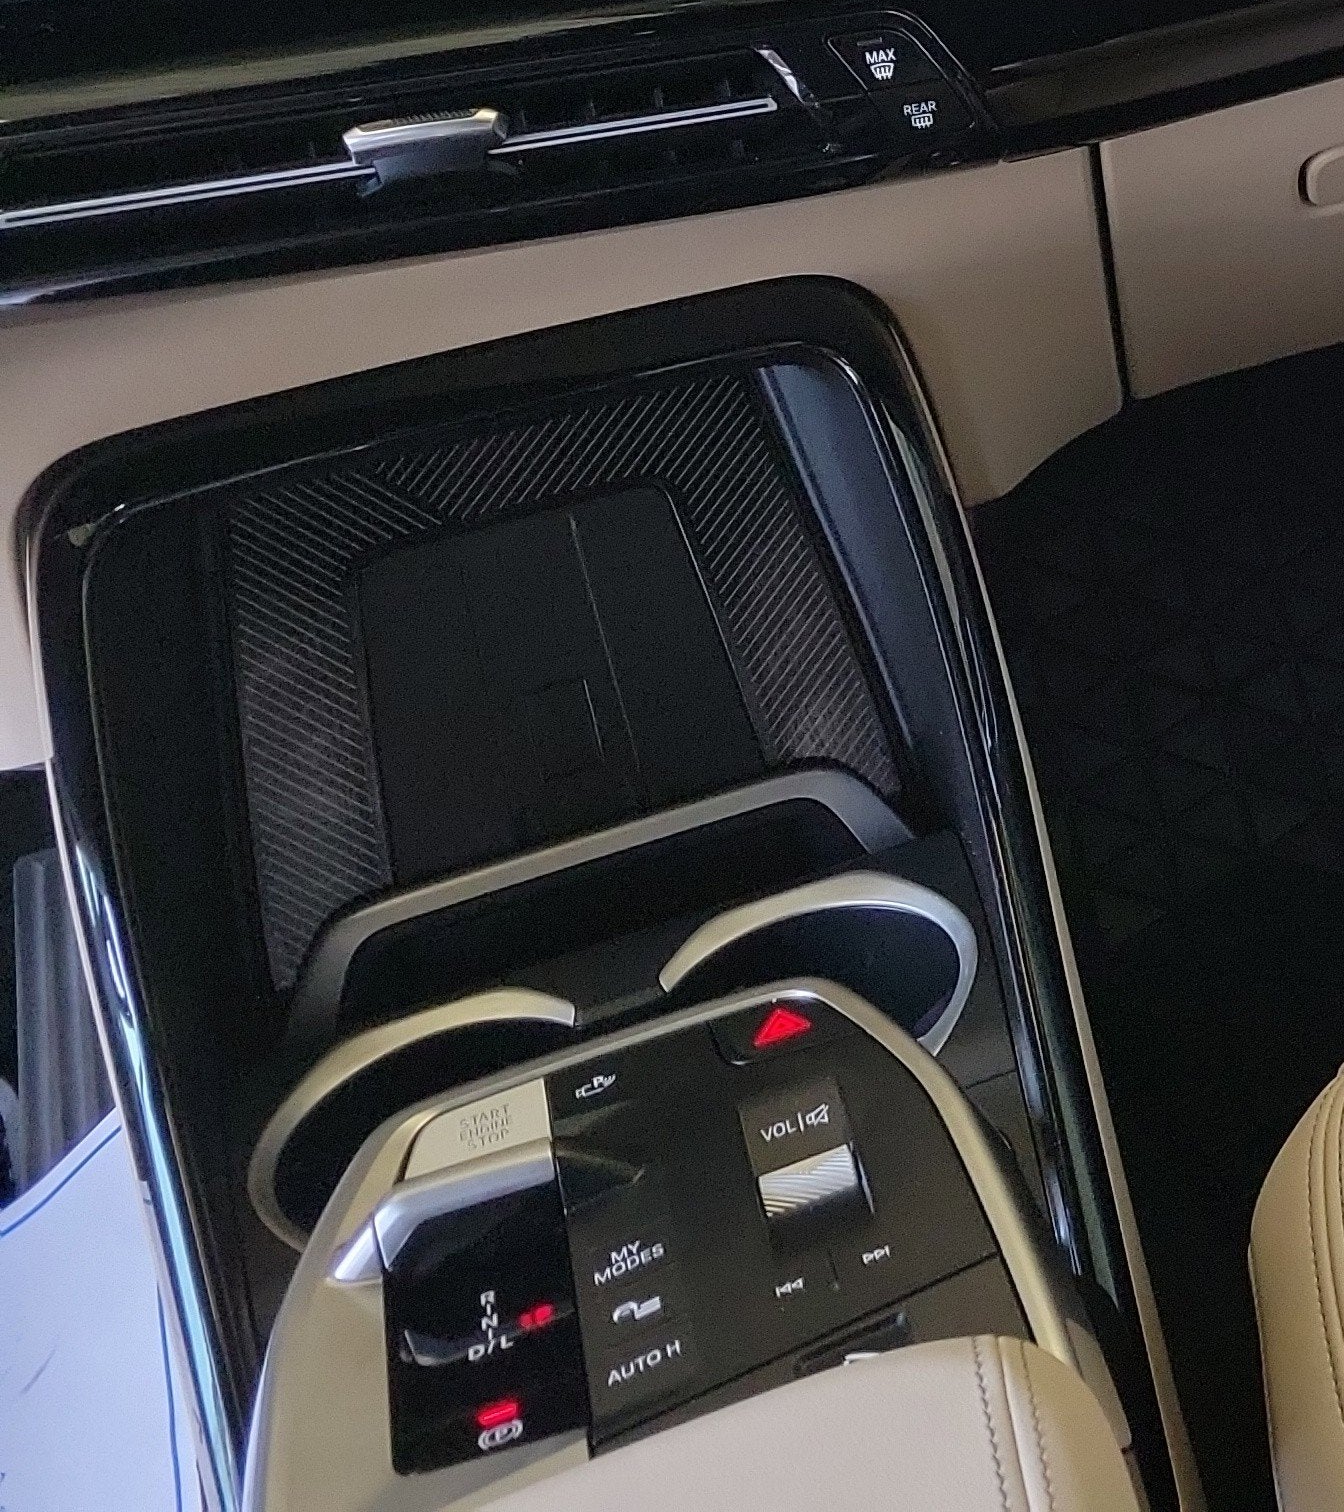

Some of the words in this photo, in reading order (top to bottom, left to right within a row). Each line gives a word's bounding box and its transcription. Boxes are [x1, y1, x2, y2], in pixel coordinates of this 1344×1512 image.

[865, 48, 896, 64] MAX
[903, 100, 937, 116] REAR
[460, 1103, 509, 1128] START
[468, 1128, 509, 1149] STOP
[760, 1118, 796, 1142] VOL
[593, 1243, 665, 1286] MODES
[610, 1240, 641, 1265] MY
[607, 1349, 662, 1387] AUTO
[666, 1340, 683, 1359] H
